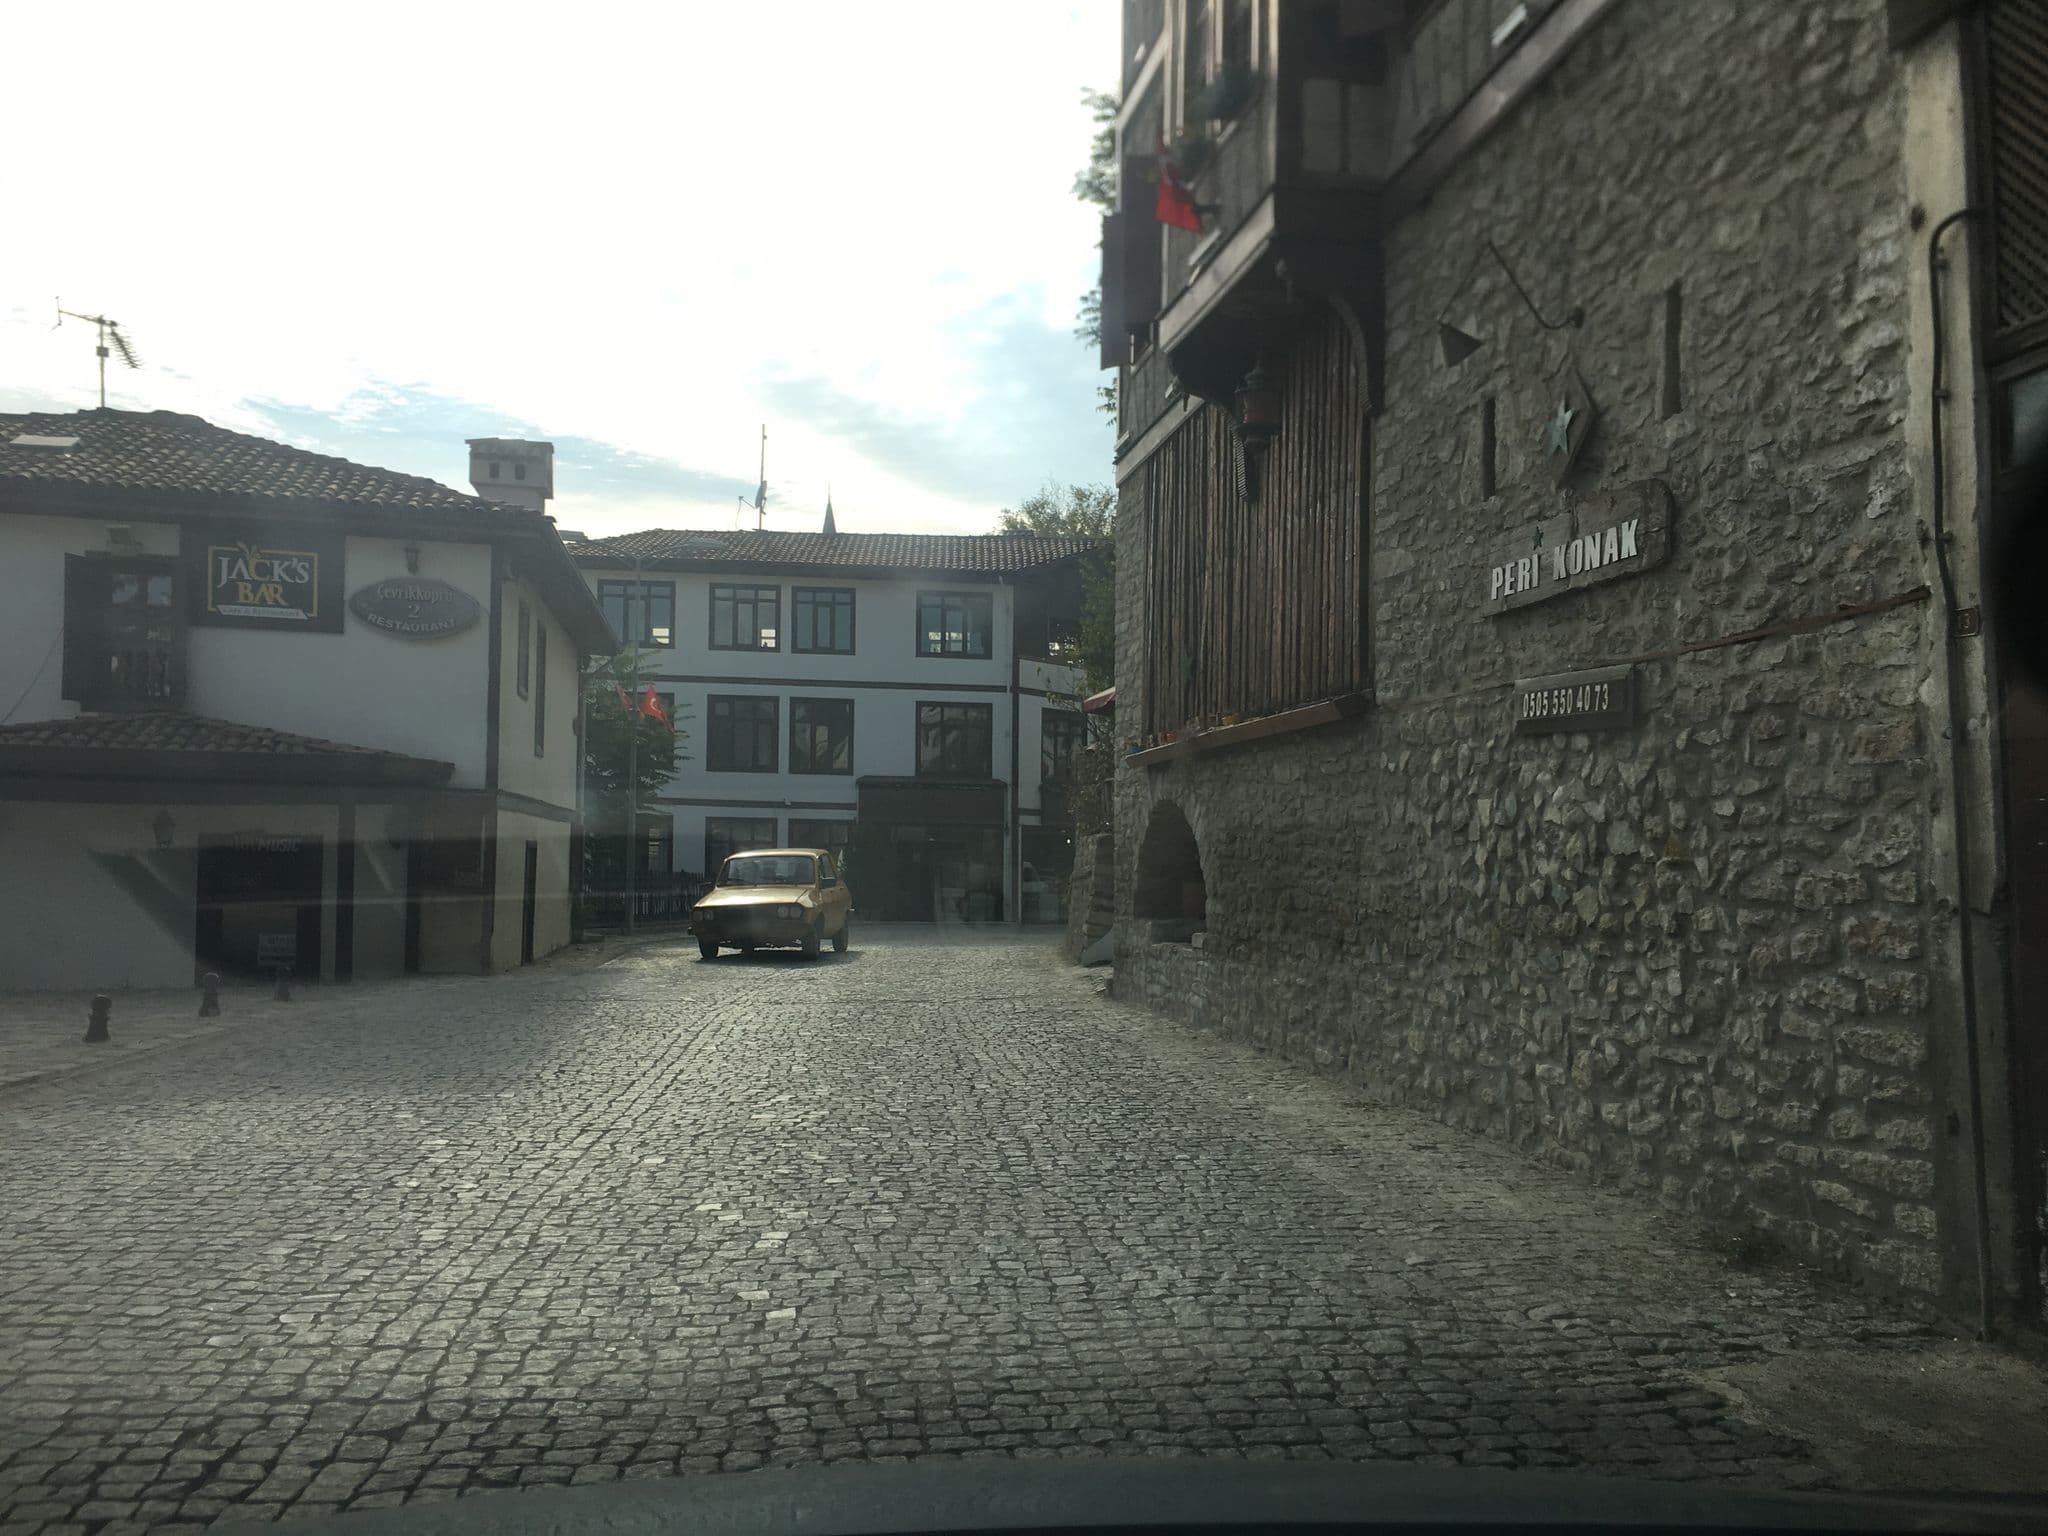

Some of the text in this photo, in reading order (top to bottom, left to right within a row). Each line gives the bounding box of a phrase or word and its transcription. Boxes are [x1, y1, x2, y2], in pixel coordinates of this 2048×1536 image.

[1552, 518, 1639, 581] KONAK
[216, 556, 310, 589] JACK'S
[235, 581, 289, 606] BAR
[366, 612, 456, 632] RESTAURANT
[407, 602, 421, 618] 2
[1522, 682, 1610, 718] 0505 550 40 73
